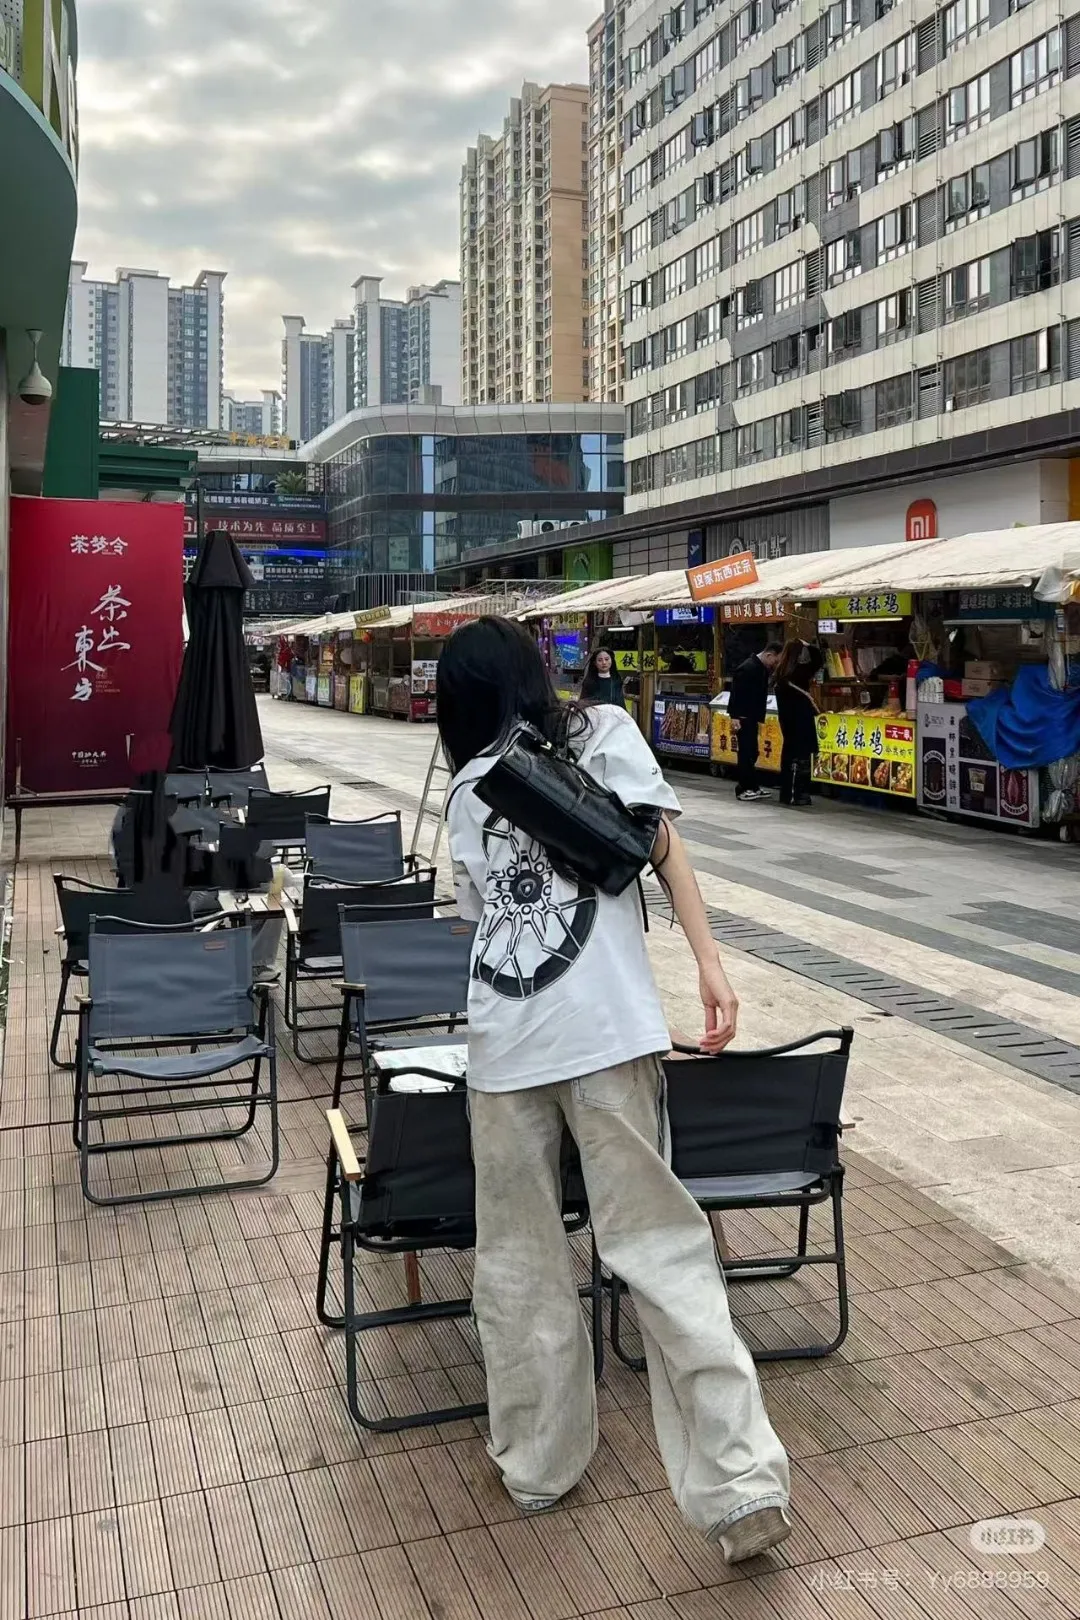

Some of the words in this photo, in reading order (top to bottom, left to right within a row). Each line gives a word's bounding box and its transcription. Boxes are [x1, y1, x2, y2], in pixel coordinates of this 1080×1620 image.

[218, 520, 265, 532] 技术为先
[272, 522, 319, 533] 品质至上
[70, 535, 128, 555] 茶梦令
[693, 559, 752, 588] 这家东西正宗
[846, 592, 900, 615] 钵钵鸡
[835, 724, 884, 756] 钵钵鸡
